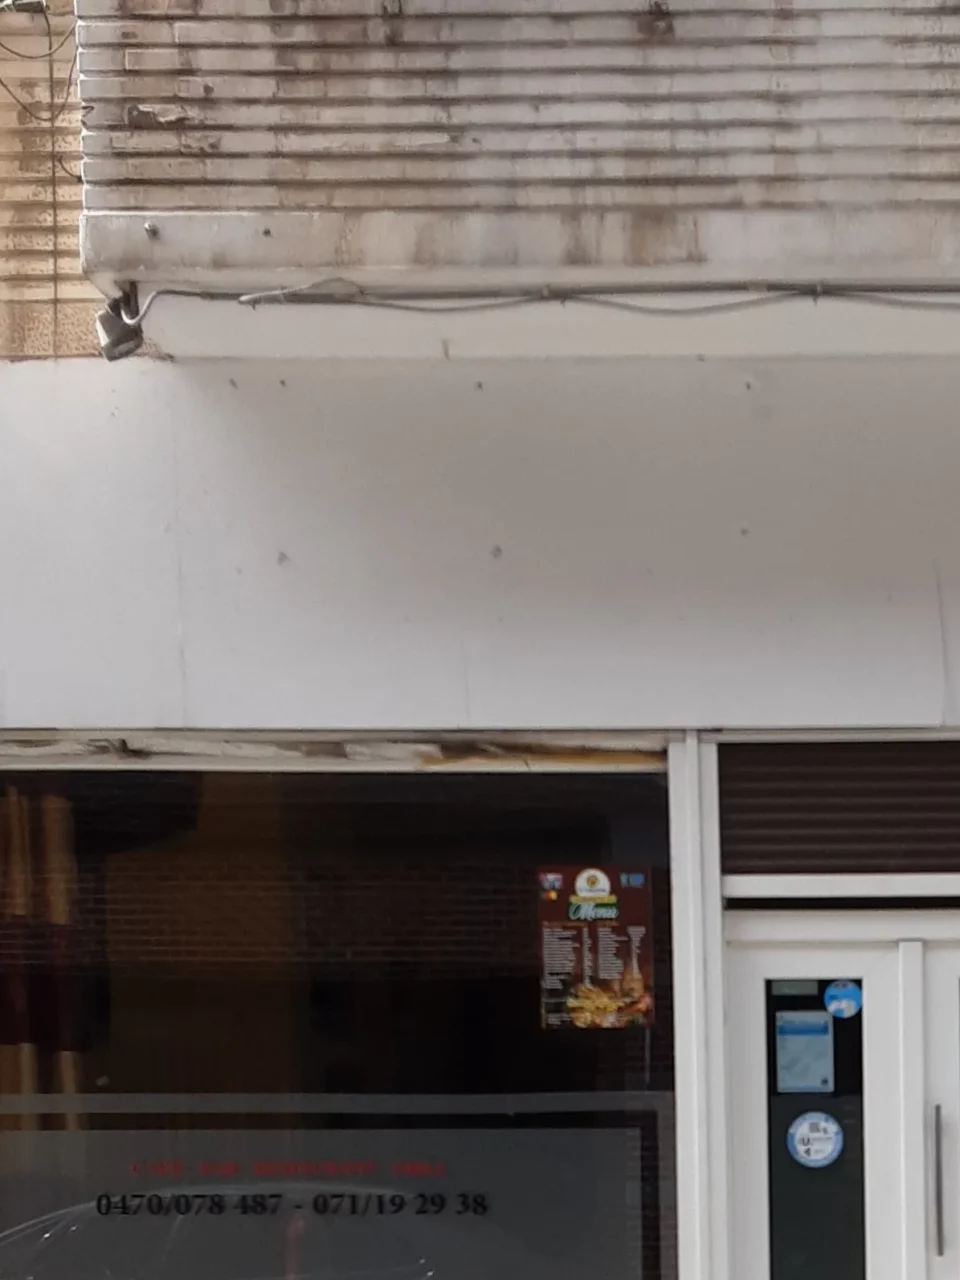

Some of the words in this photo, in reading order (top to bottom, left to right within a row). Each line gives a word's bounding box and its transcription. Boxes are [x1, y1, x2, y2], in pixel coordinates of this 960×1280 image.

[96, 1193, 225, 1216] 0470/078
[233, 1193, 282, 1215] 487
[313, 1192, 405, 1217] 071/19
[414, 1192, 446, 1215] 29
[455, 1192, 489, 1215] 38
